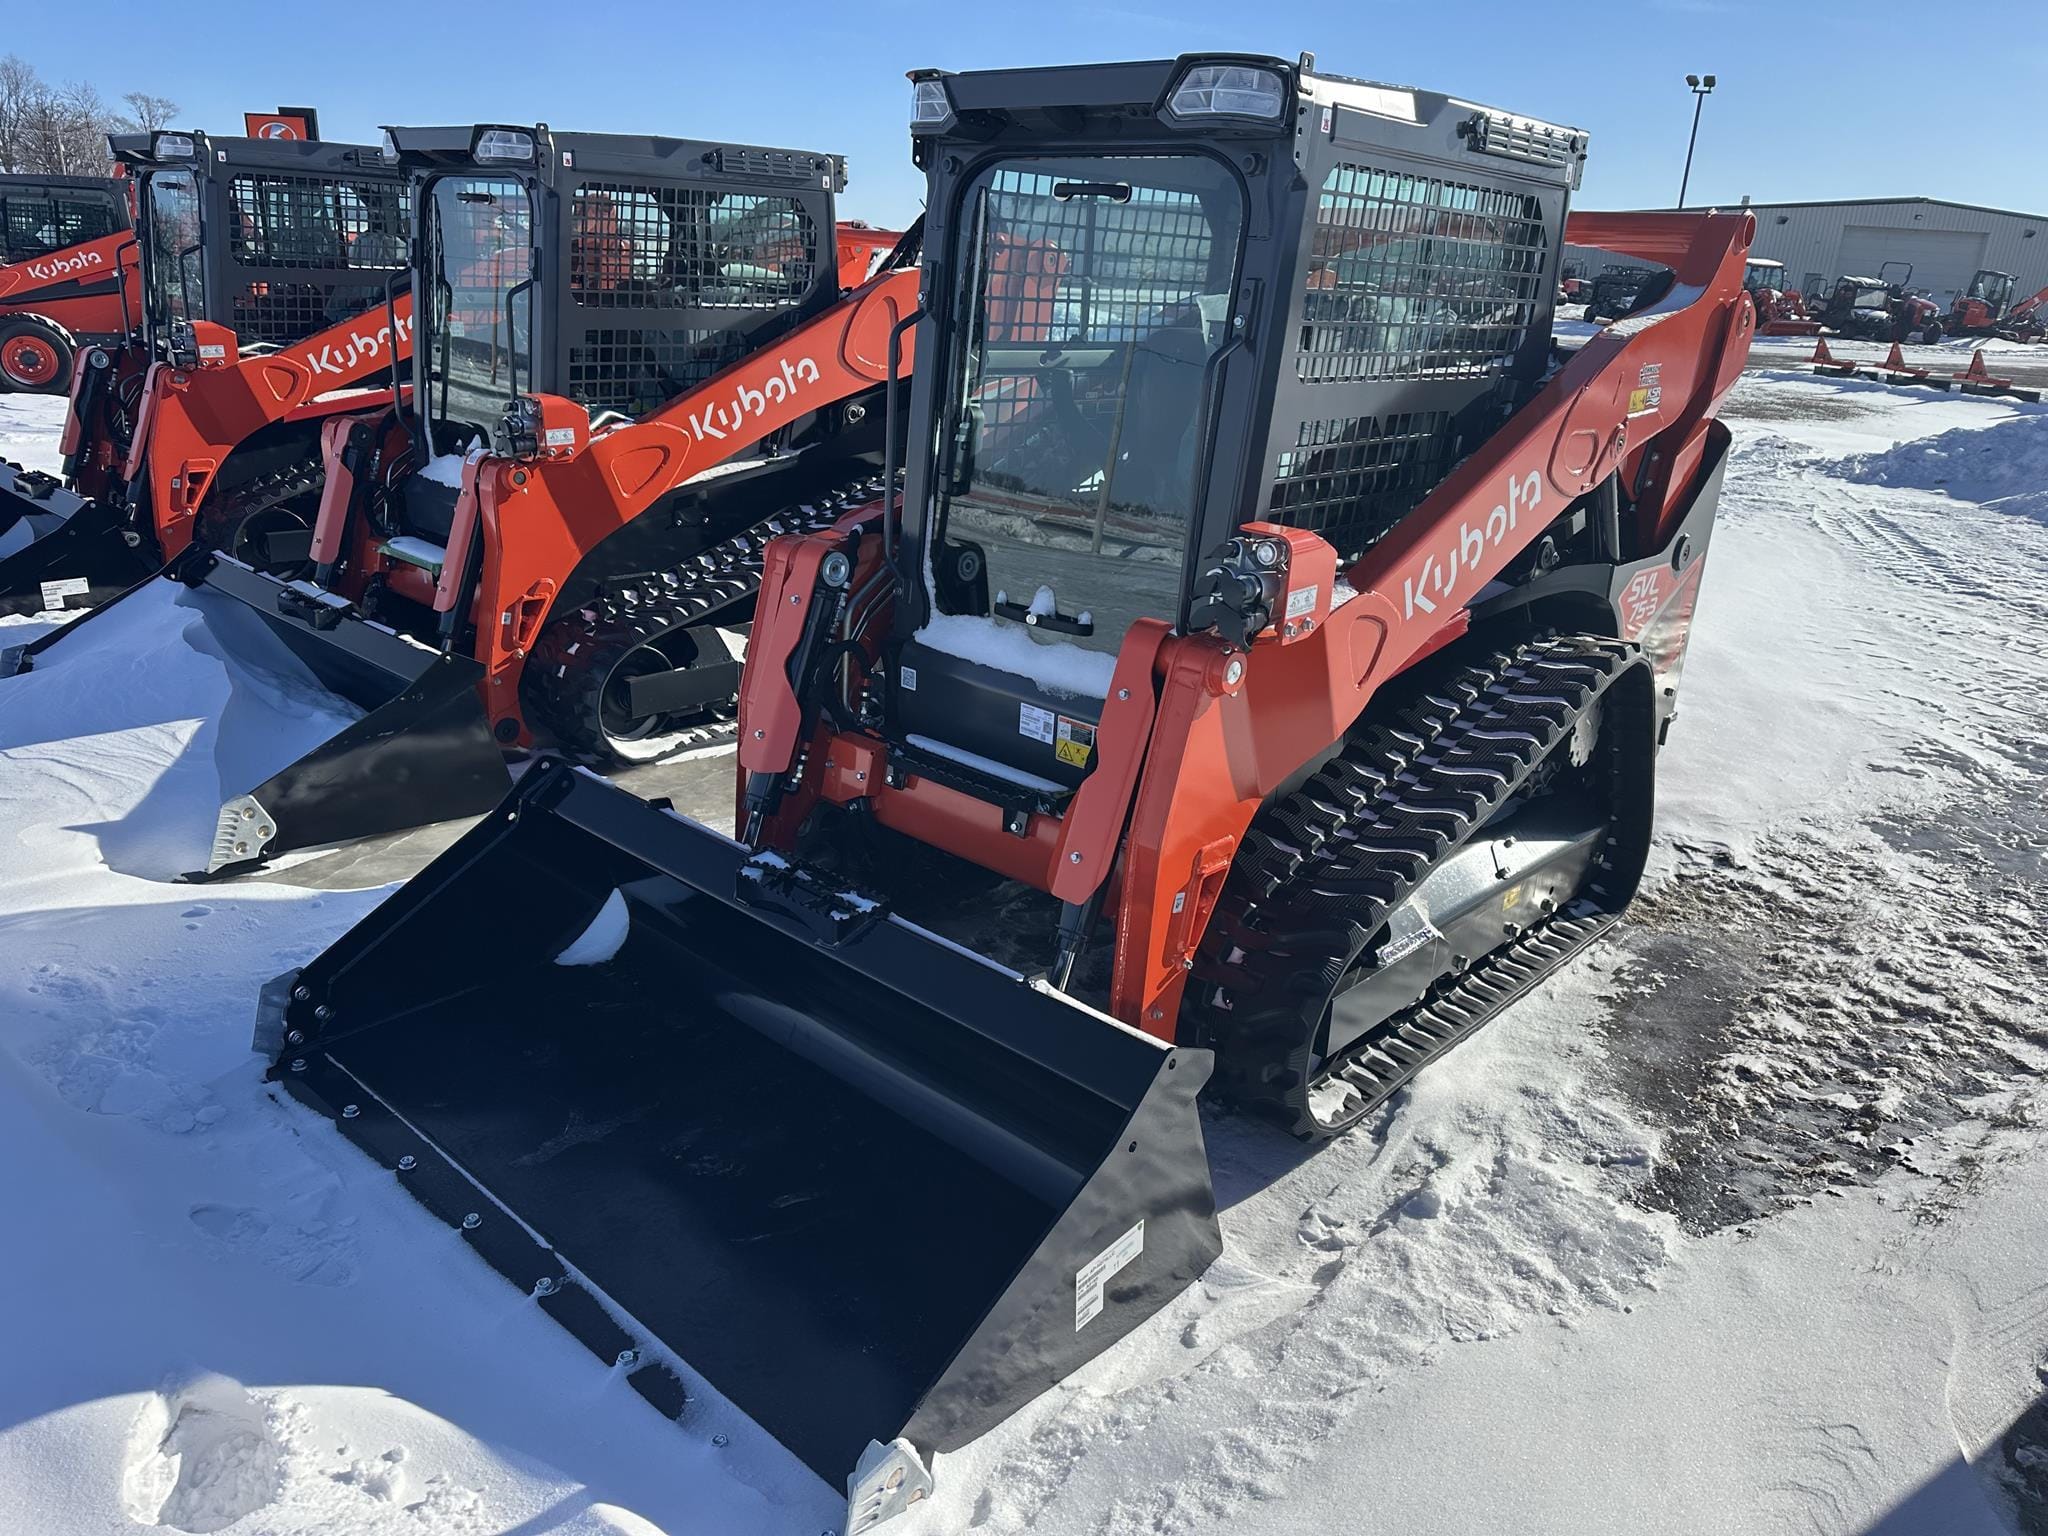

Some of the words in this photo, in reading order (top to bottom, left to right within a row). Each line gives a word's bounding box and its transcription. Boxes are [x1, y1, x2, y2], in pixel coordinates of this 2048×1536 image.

[27, 251, 102, 279] Kubota
[306, 313, 413, 374] Kubot
[689, 358, 820, 441] Kubota
[1404, 470, 1541, 620] Kubota
[1627, 572, 1659, 602] SVL
[1629, 597, 1658, 623] 75-3
